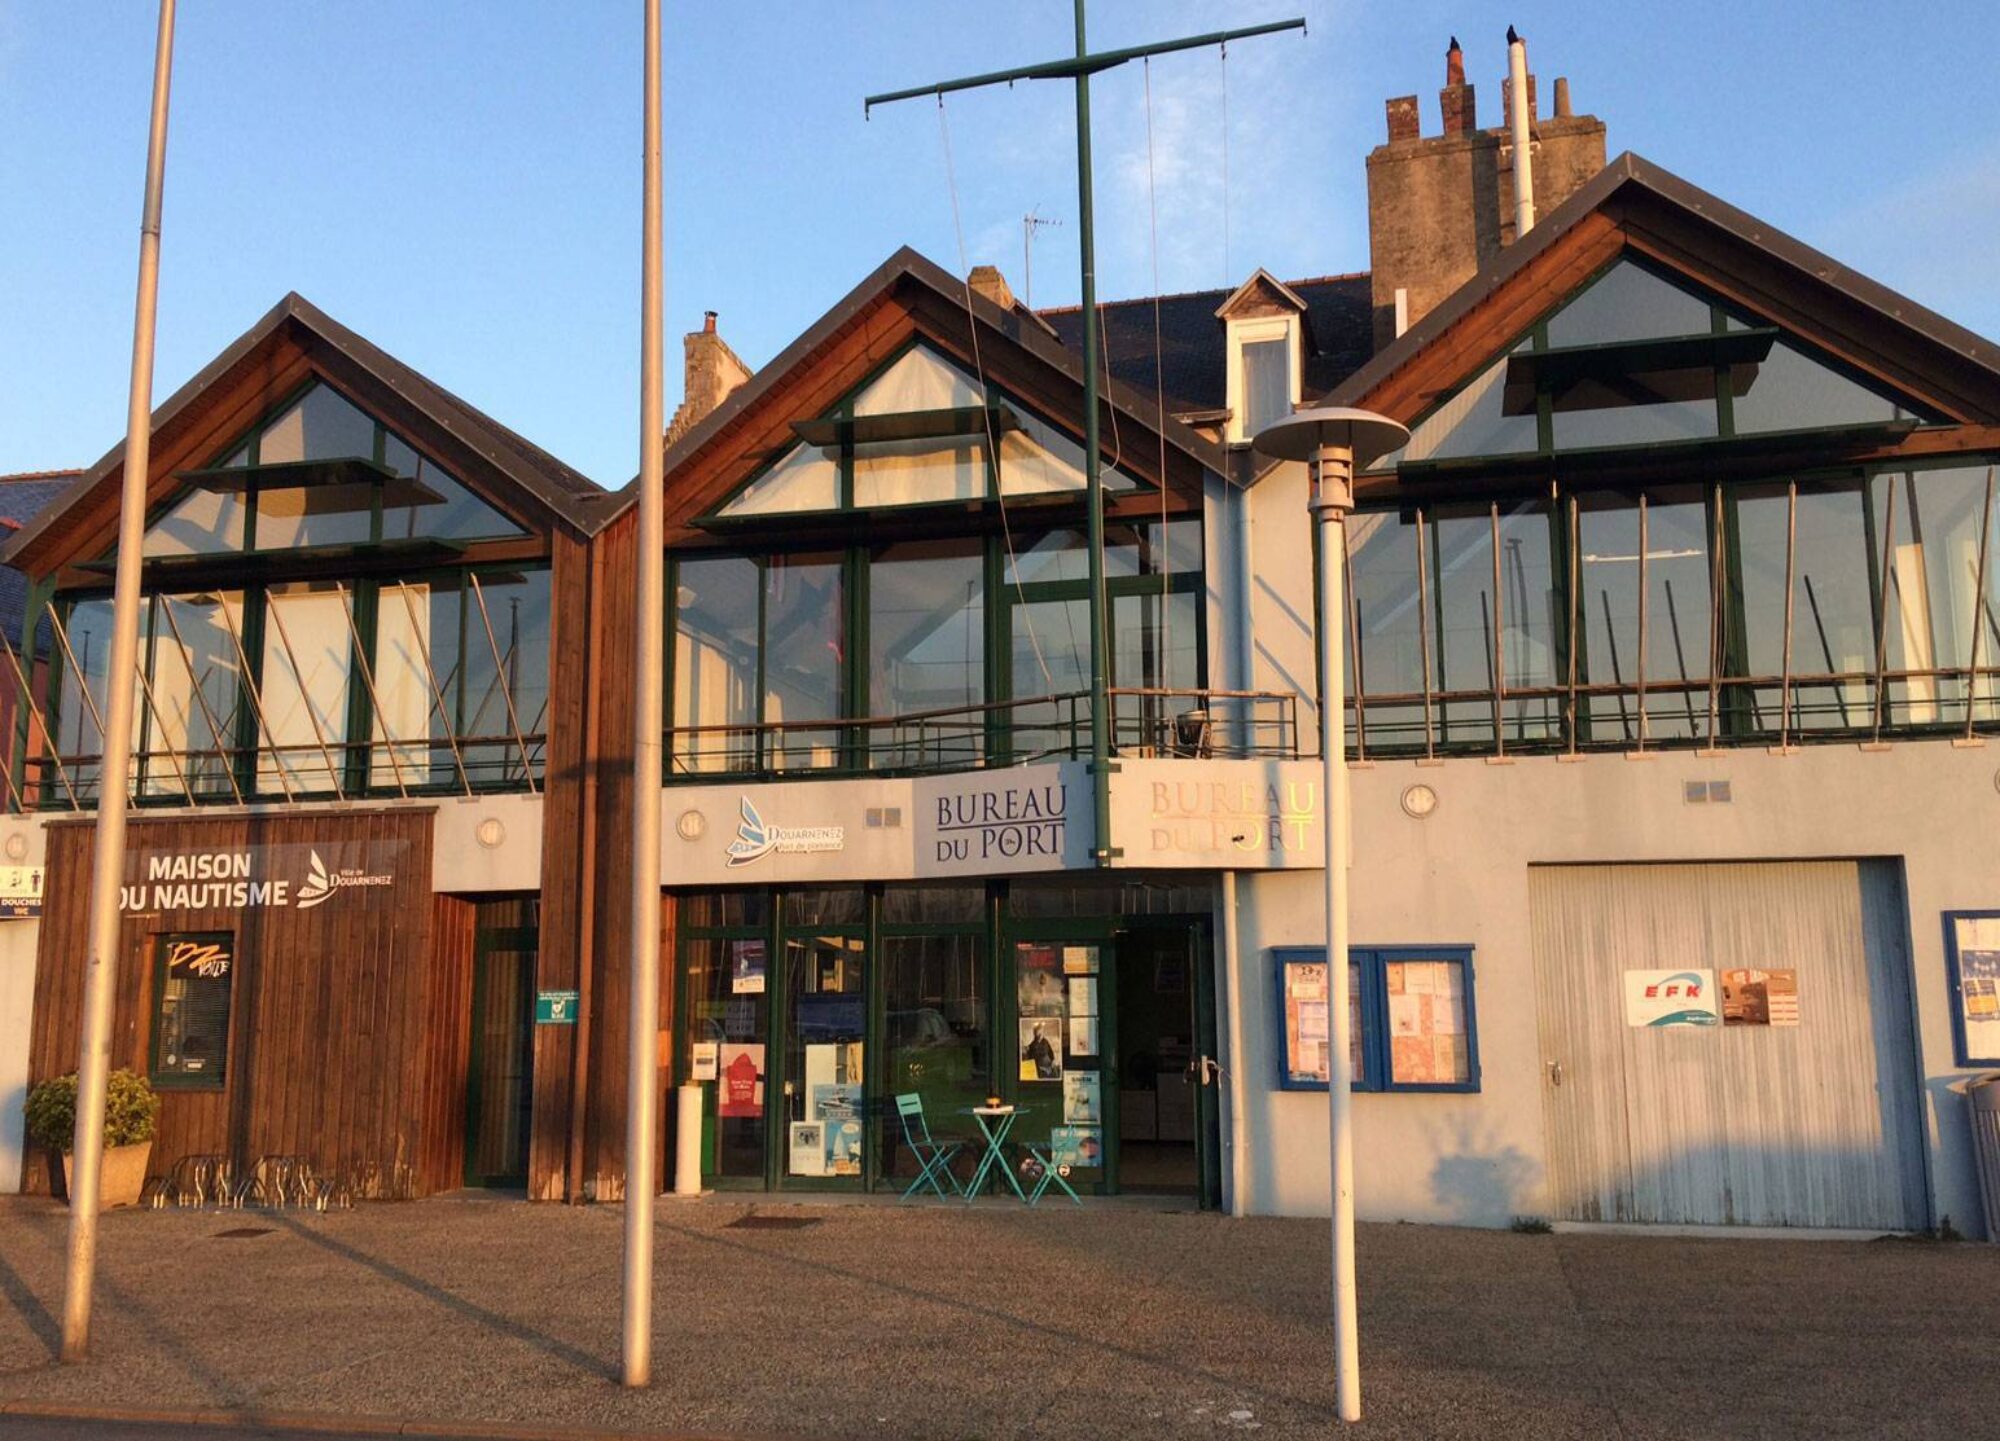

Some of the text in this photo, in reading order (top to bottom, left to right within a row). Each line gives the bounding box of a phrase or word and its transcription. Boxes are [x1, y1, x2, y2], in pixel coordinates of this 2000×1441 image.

[937, 784, 1067, 825] BUREAU
[1151, 781, 1315, 816] BUREAU
[936, 822, 1066, 862] DU PORT
[1151, 819, 1314, 851] DU PORT
[148, 853, 251, 881] MAISON
[153, 880, 290, 910] NAUTISME
